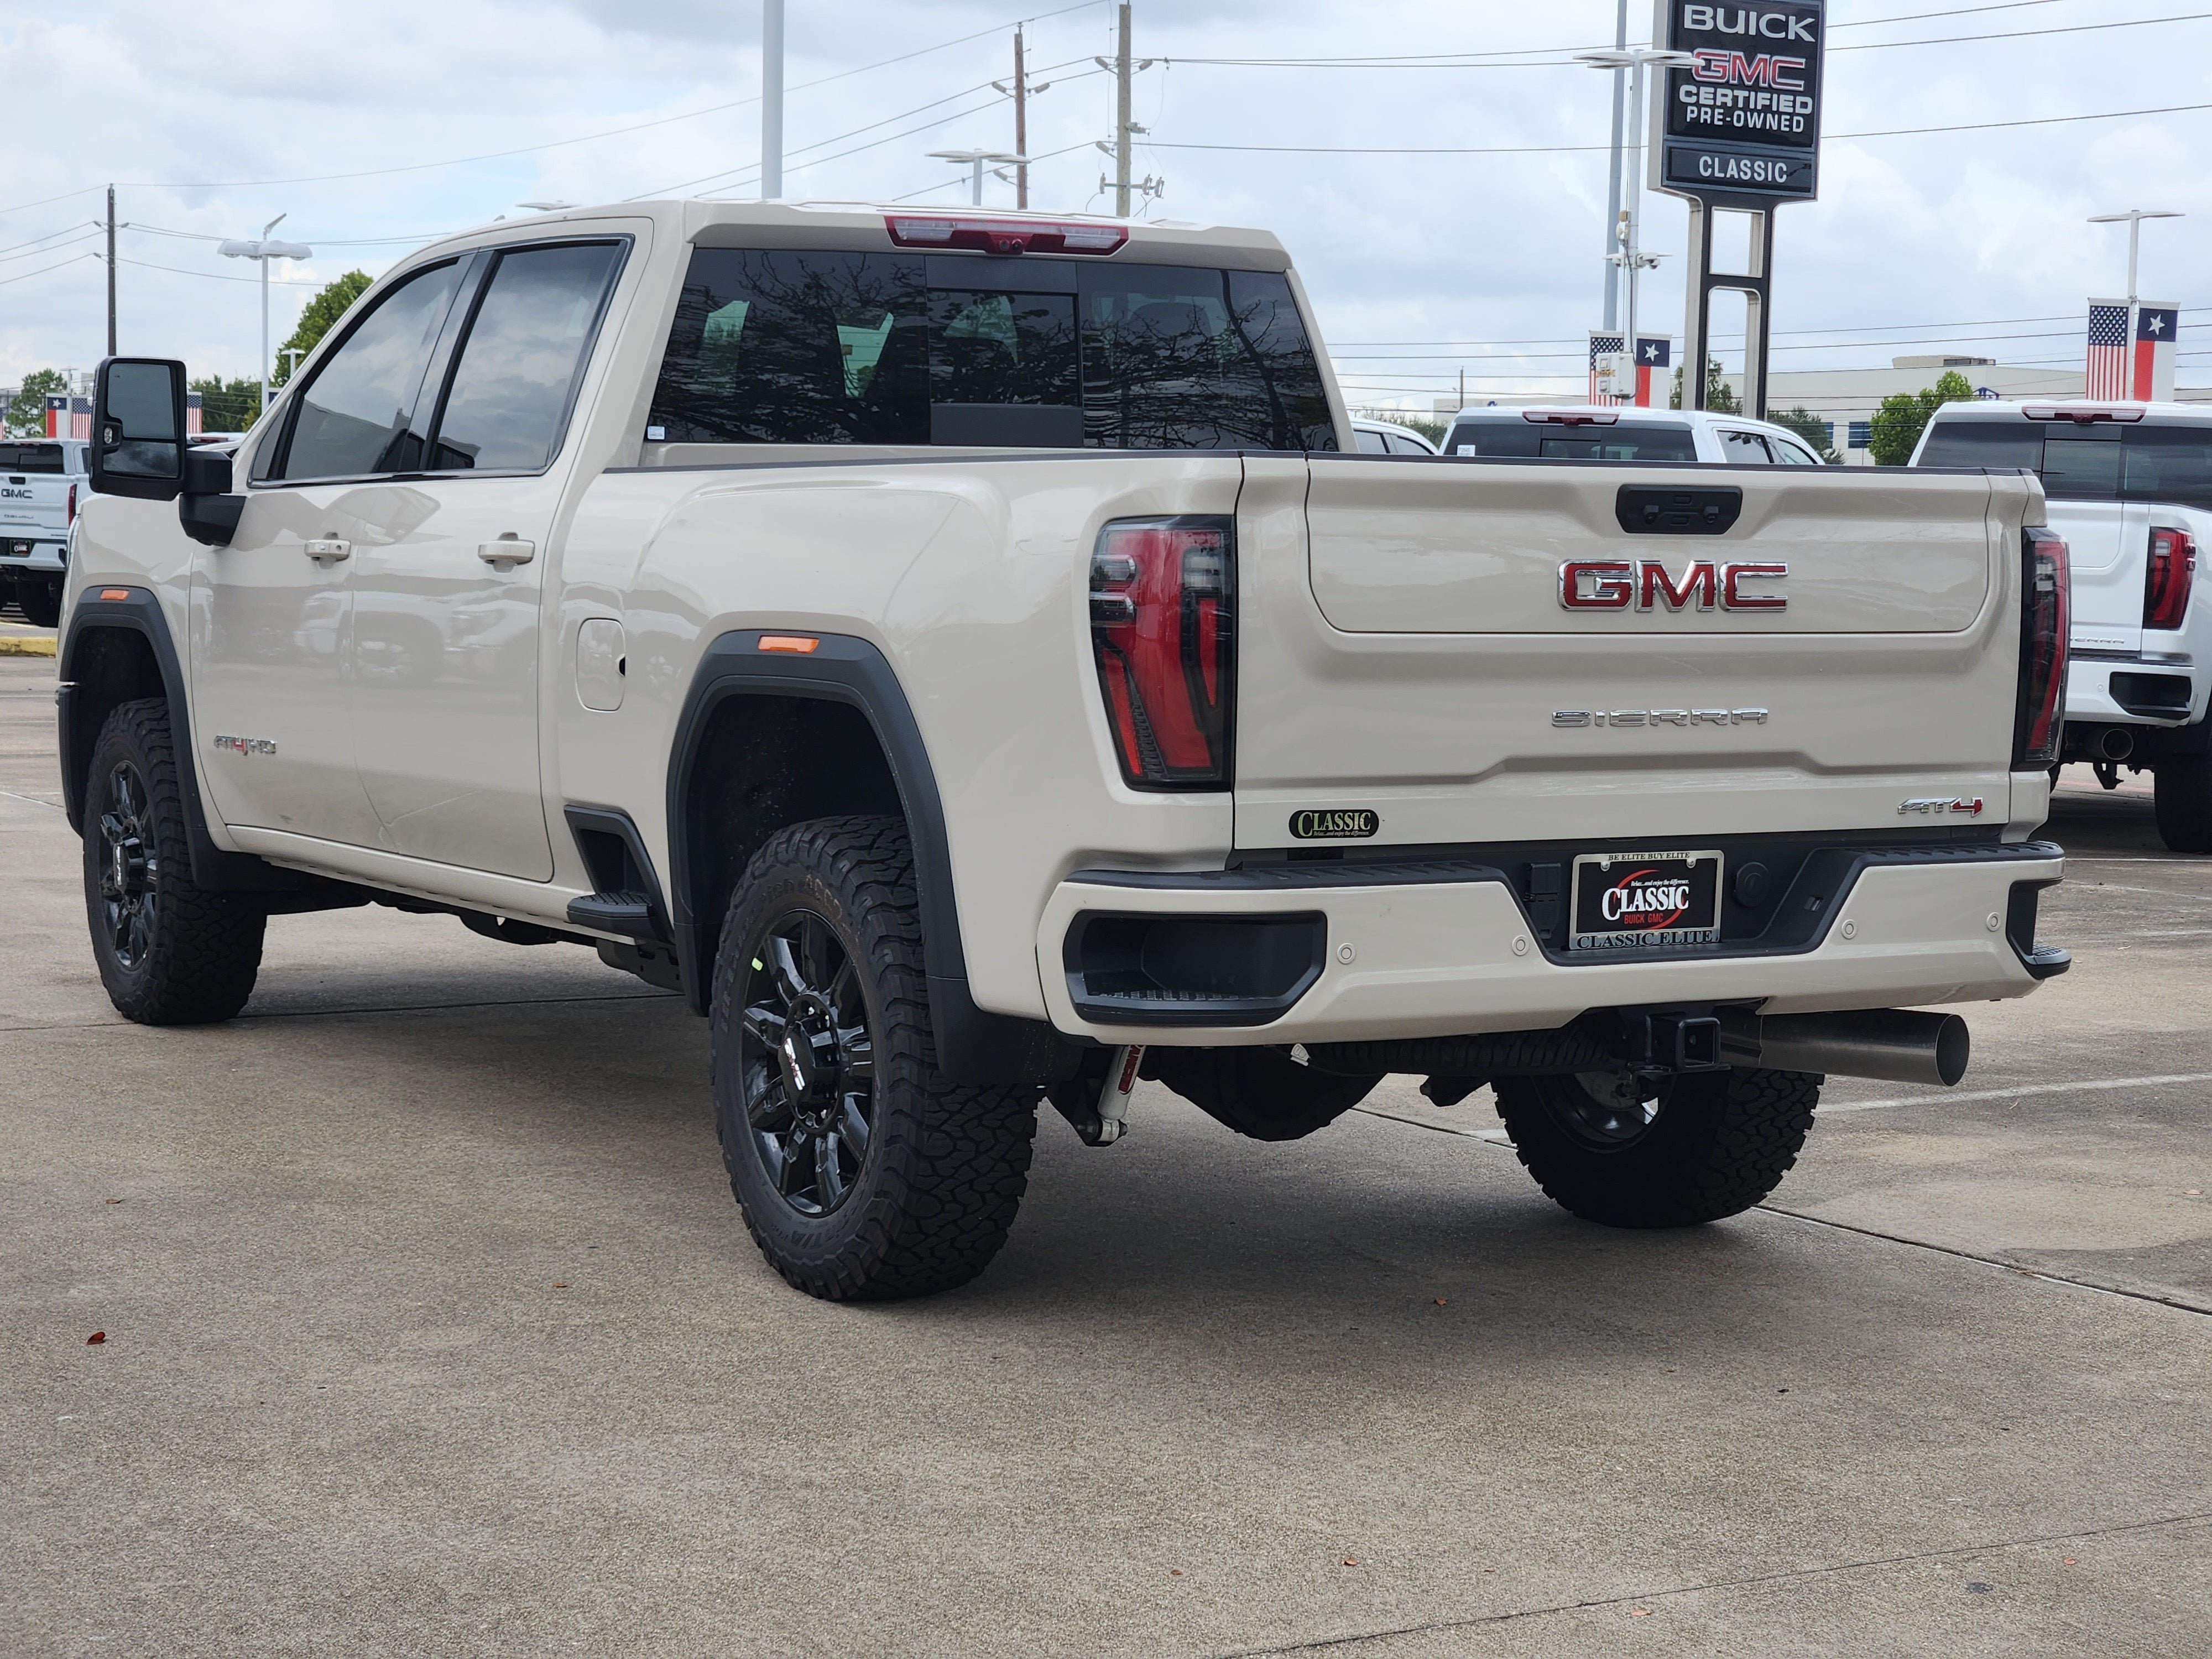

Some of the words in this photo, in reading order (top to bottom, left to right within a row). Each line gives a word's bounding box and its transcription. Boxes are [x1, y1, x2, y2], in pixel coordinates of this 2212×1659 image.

[1684, 4, 1815, 42] BUICK
[1693, 49, 1806, 91] GMC
[1679, 85, 1812, 114] CERTIFIED
[1687, 106, 1804, 132] PRE-OWNED
[1699, 156, 1787, 184] CLASSIC
[1, 489, 33, 499] GMC
[1557, 559, 1788, 612] GMC
[1552, 708, 1768, 727] SIERRA
[1898, 797, 1984, 818] AT4
[1298, 812, 1371, 837] CLASSIC
[1602, 886, 1689, 921] CLASSIC
[1624, 913, 1644, 924] BUICK
[1648, 912, 1663, 923] GMC
[1577, 932, 1655, 949] CLASSIC
[1660, 930, 1713, 945] ELITE
